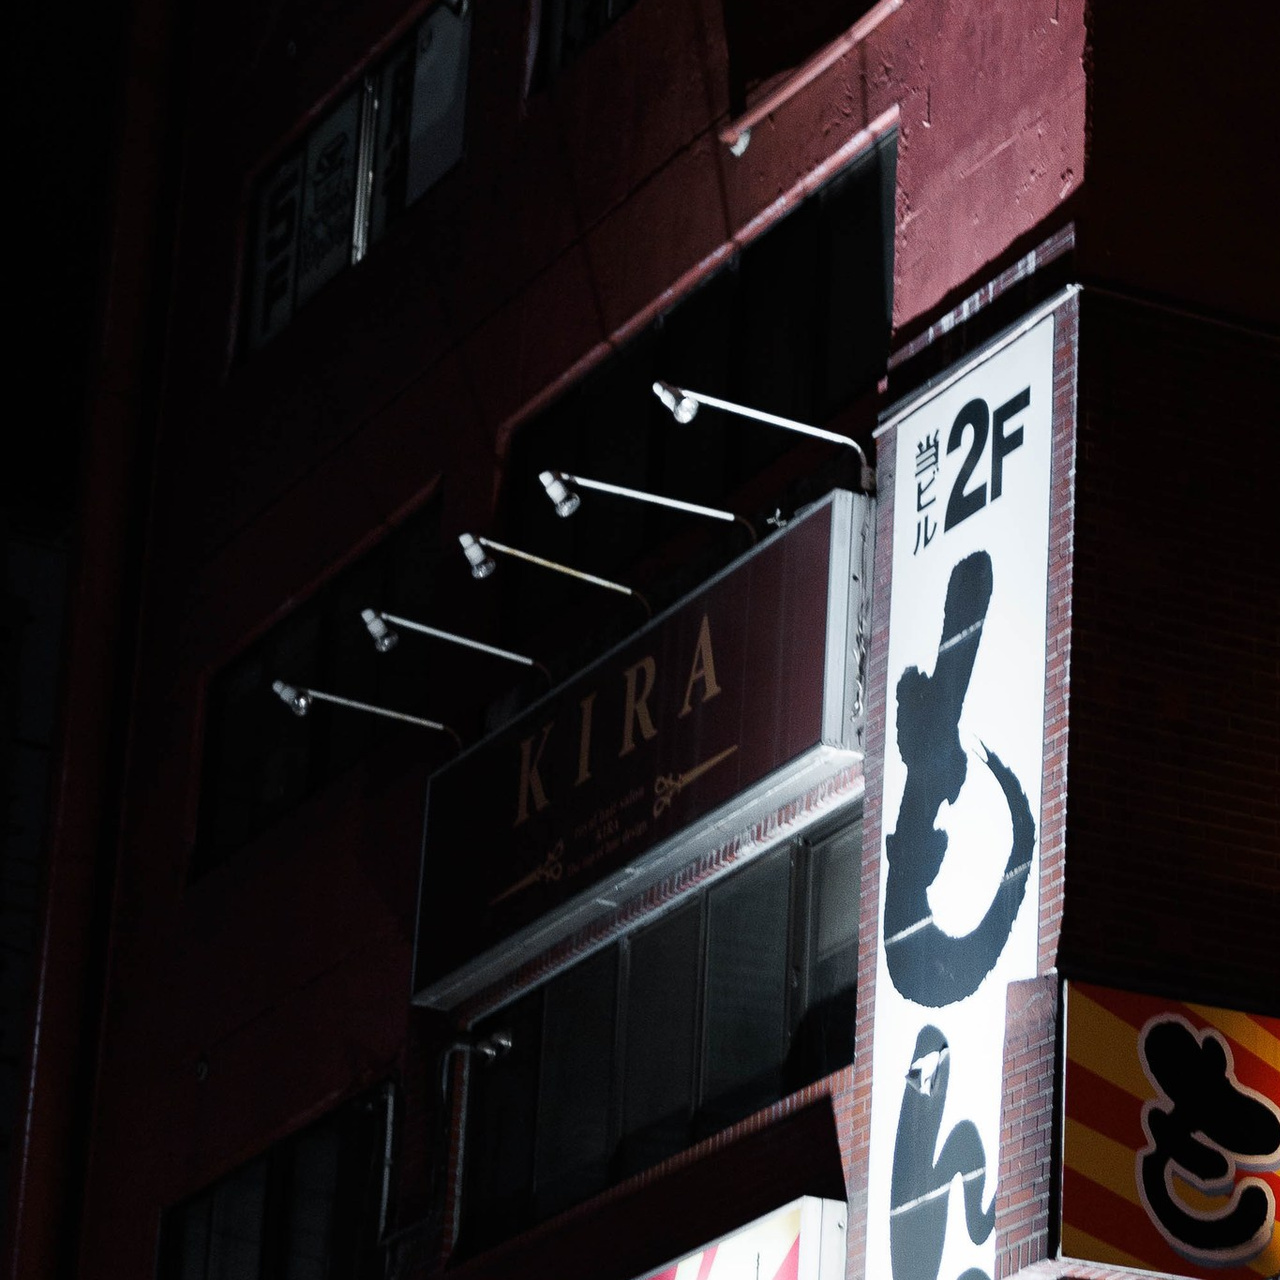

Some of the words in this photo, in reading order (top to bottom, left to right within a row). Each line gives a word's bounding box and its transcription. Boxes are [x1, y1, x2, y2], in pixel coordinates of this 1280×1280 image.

[914, 428, 939, 555] 当ビル
[943, 385, 1030, 534] 2F
[512, 612, 722, 829] KIRA
